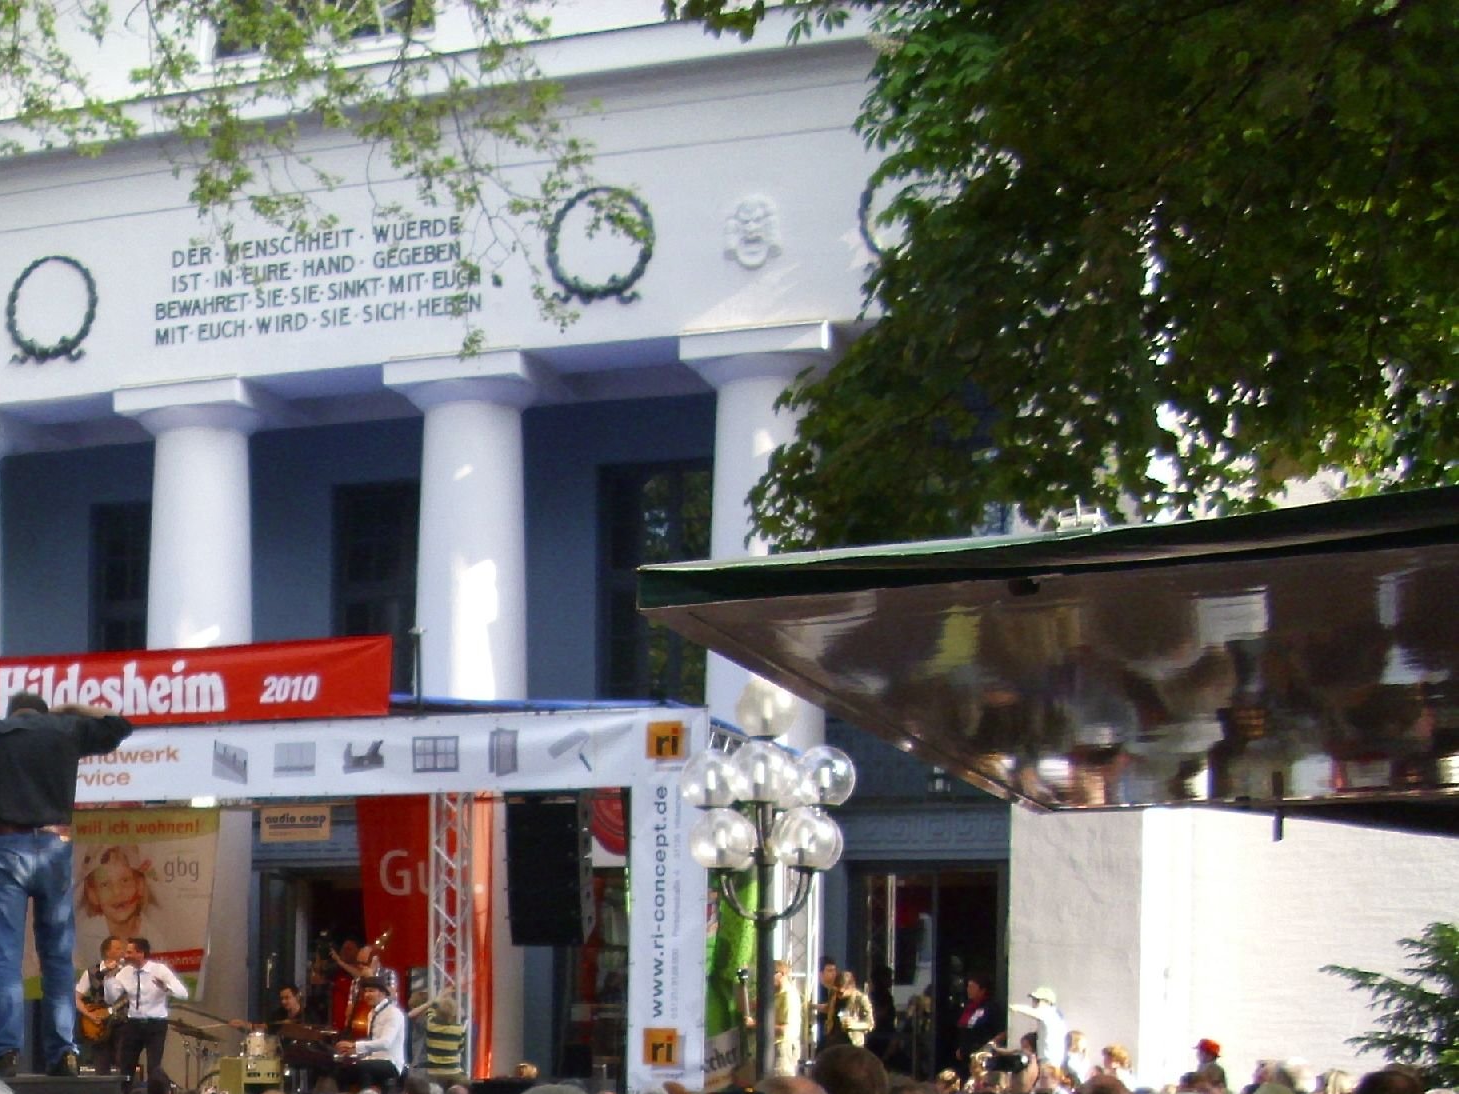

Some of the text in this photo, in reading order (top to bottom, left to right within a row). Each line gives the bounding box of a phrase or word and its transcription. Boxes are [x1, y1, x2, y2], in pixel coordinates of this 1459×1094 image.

[172, 246, 212, 268] DER
[374, 216, 461, 244] WUERDE
[172, 241, 461, 292] IST IN EURE HAND GEGEBEN
[155, 267, 480, 320] BEWAHRET SIE SIE SINKT MIT EUCH
[155, 293, 482, 346] MIT EUCH WIRD SIE SICH HEBEN
[259, 675, 319, 704] 2010
[79, 746, 180, 765] andwerk
[77, 769, 131, 787] rvice
[107, 819, 129, 834] ich
[135, 818, 200, 834] wohnen!
[164, 855, 200, 881] gbg
[652, 786, 669, 1018] www.ri-concept.de
